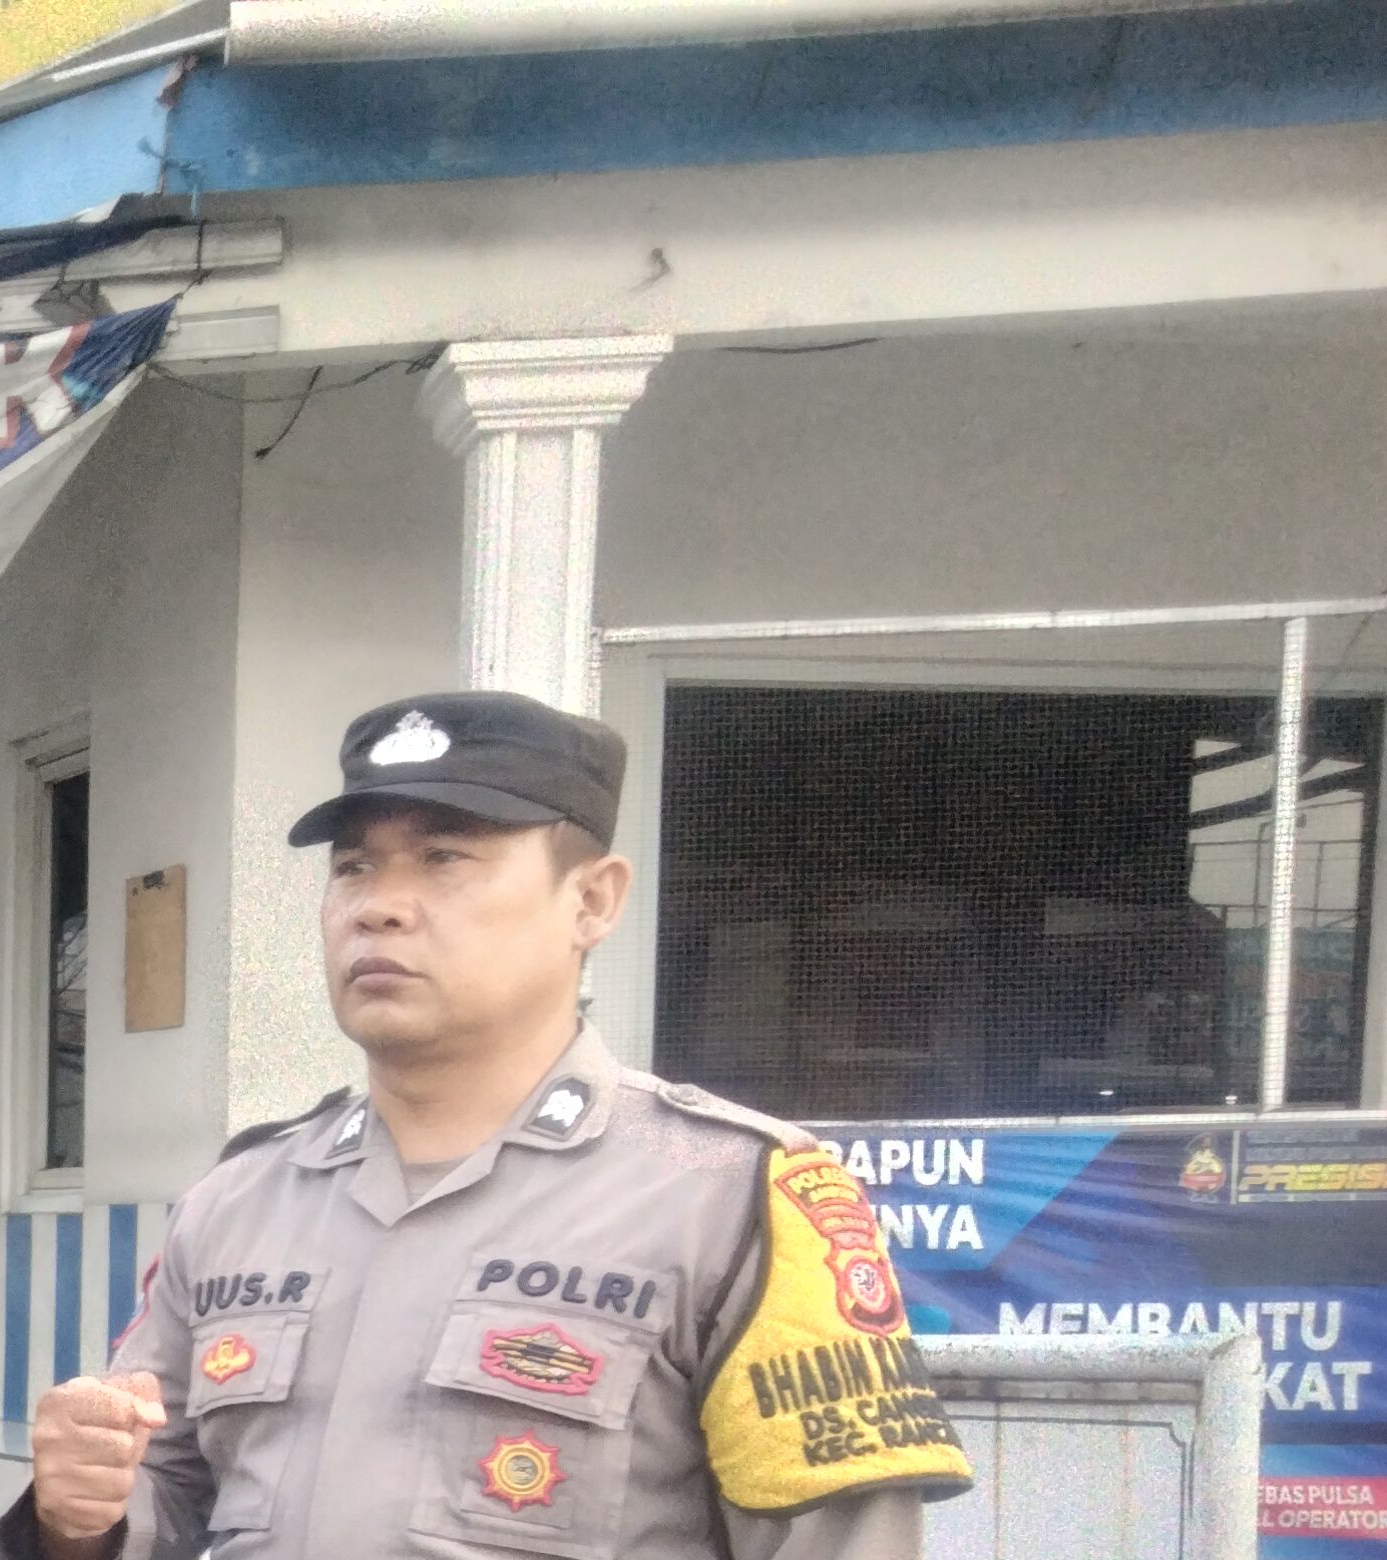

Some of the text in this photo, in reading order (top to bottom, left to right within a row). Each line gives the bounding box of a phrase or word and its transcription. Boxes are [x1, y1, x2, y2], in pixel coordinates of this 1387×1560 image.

[875, 1204, 984, 1249] NYA
[477, 1258, 657, 1319] POLRI
[999, 1300, 1342, 1351] MEMBANTU
[800, 1406, 857, 1441] DS.
[803, 1431, 878, 1467] KEC.
[1308, 1485, 1374, 1505] PULSA
